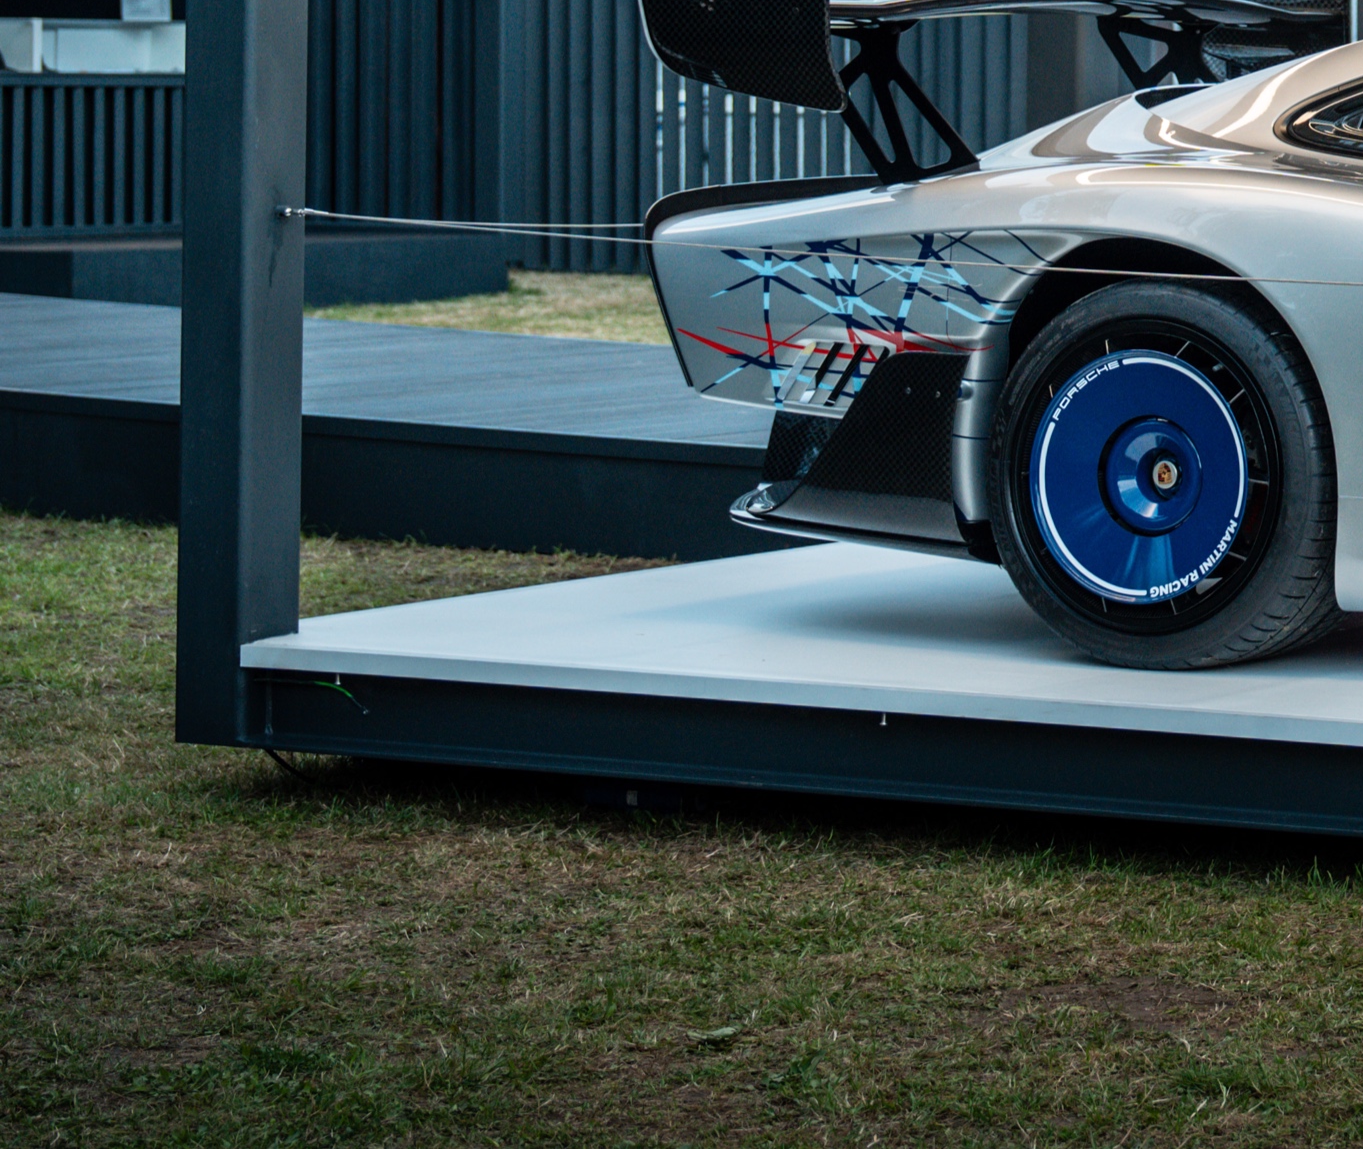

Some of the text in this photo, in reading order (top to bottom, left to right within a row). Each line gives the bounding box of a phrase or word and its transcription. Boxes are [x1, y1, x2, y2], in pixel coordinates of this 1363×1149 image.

[1052, 359, 1120, 421] PORSCHE
[1149, 518, 1238, 598] MARTINI RACING
